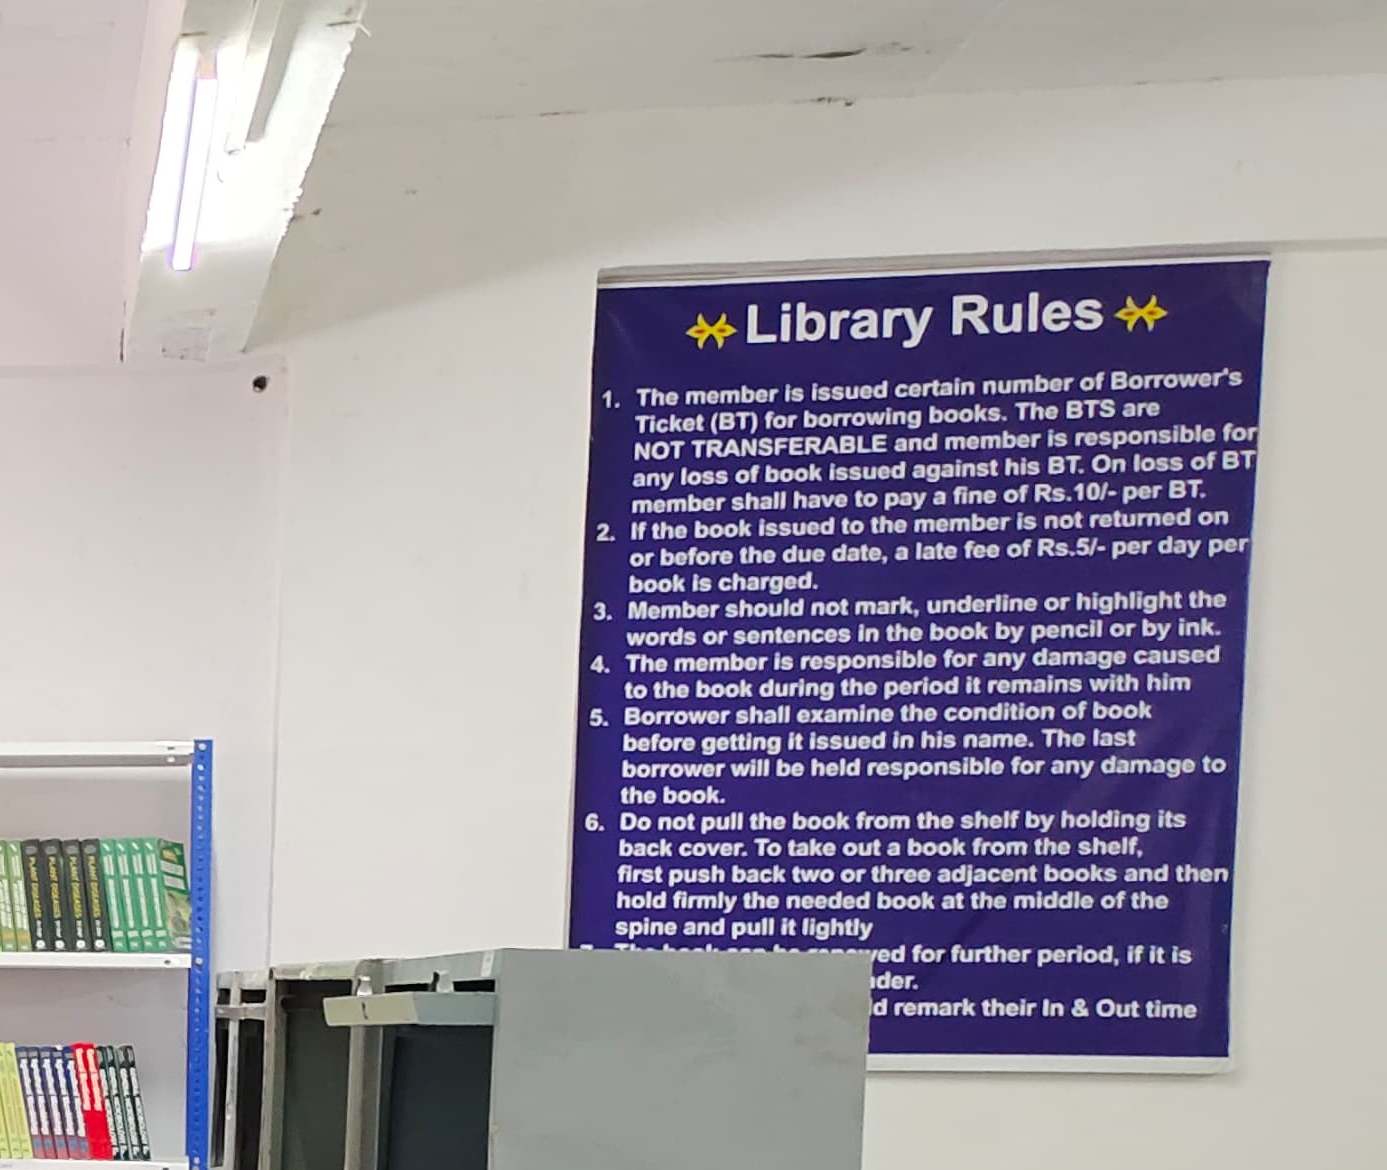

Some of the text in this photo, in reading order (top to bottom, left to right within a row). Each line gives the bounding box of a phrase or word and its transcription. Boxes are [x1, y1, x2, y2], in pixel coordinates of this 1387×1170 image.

[747, 291, 1103, 349] Library Rules
[603, 367, 1242, 408] 1. The member is issued certain number of Borrower's
[635, 399, 1160, 435] Ticket (BT) for borrowing books. The BTS are
[635, 420, 1257, 461] NOT TRANSFERABLE and member is responsible for
[632, 479, 1205, 514] member shall have to pay a fine of Rs.10/- per BT.
[629, 570, 818, 594] book is charged.
[594, 590, 1227, 621] 3. Member should not mark, underline or highlight the
[590, 700, 1151, 726] 5. Borrower shall examine the condition of book
[621, 785, 725, 805] the book.
[585, 809, 1186, 834] 6. Do not pull the book from the shelf by holding its
[616, 917, 873, 940] spine and pull it lightly
[912, 943, 945, 962] for
[951, 944, 1031, 962] further
[1038, 944, 1118, 967] period,
[1128, 944, 1144, 963] if
[1150, 945, 1165, 964] it
[1172, 945, 1192, 964] is
[894, 997, 975, 1016] remark
[982, 998, 1037, 1016] their
[1043, 998, 1064, 1016] In
[1072, 998, 1089, 1017] &
[1096, 998, 1139, 1017] Out
[1146, 999, 1197, 1018] time
